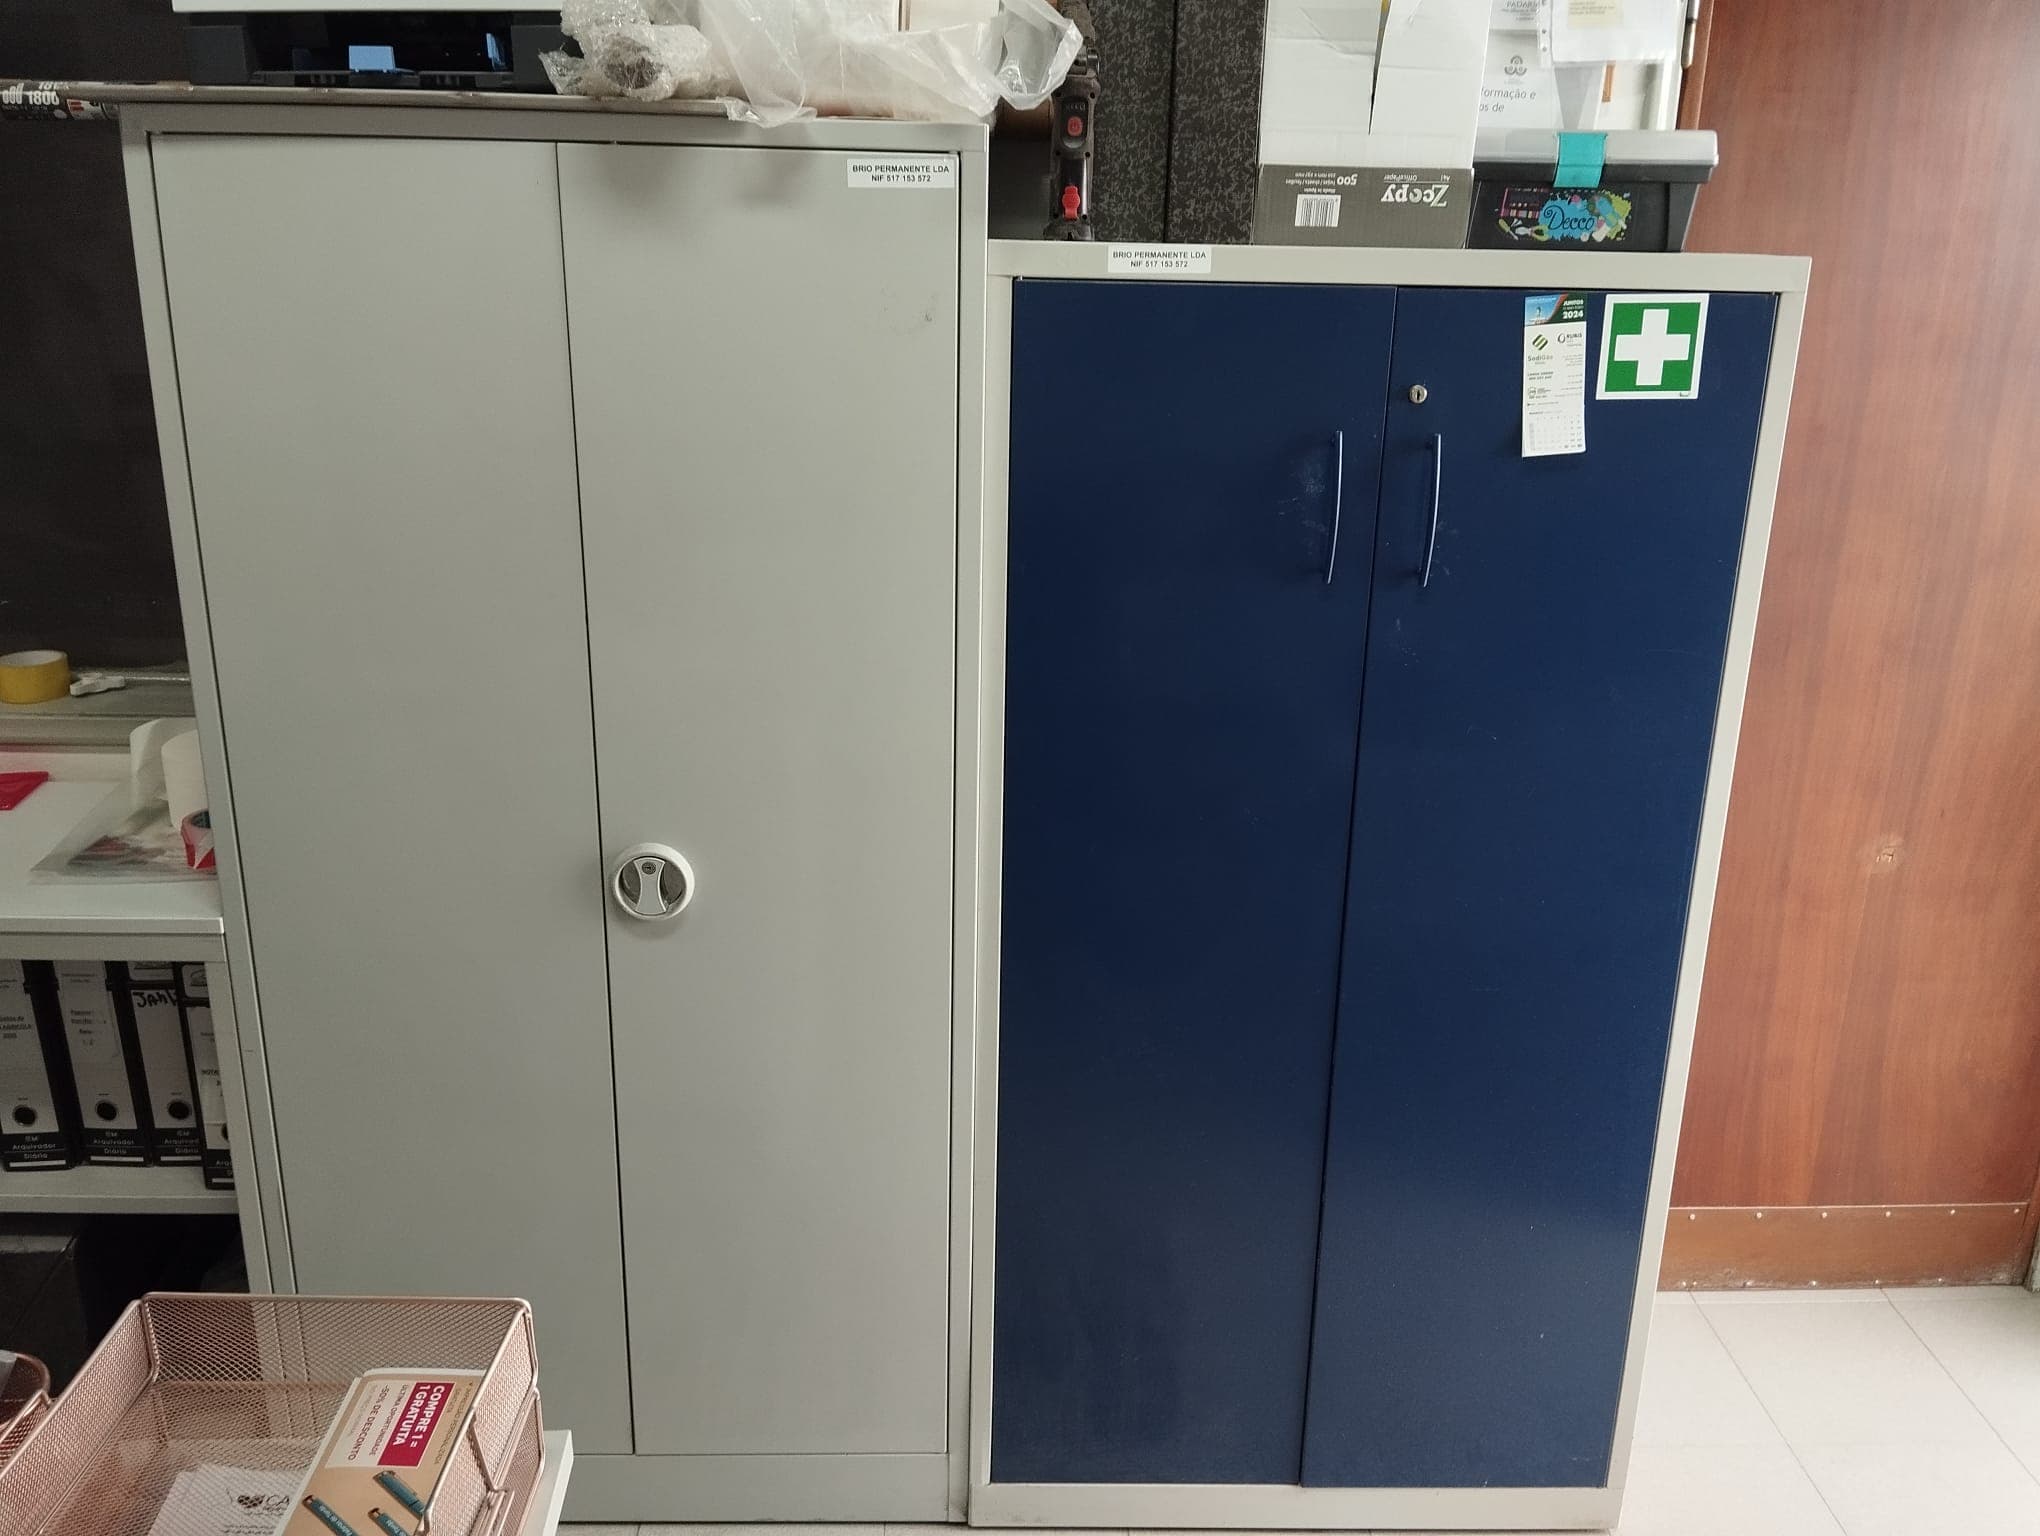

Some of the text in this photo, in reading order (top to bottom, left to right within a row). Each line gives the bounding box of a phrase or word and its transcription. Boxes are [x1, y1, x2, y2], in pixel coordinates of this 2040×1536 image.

[1492, 102, 1505, 112] de
[852, 165, 950, 173] BRIO PERMANENTE LDA
[871, 174, 931, 182] NIF 517 153 572
[1336, 173, 1358, 186] 500
[1380, 183, 1450, 207] Zcopy
[1543, 204, 1595, 231] Decco
[1113, 251, 1206, 259] BRIO PERMANENTE LDA
[1130, 260, 1188, 268] NIF 517 153 572
[1562, 310, 1584, 320] 2024
[370, 1404, 382, 1416] DE
[415, 1385, 445, 1433] COMPRE
[393, 1391, 428, 1446] GRATUITA
[347, 1416, 376, 1461] DESCONTO
